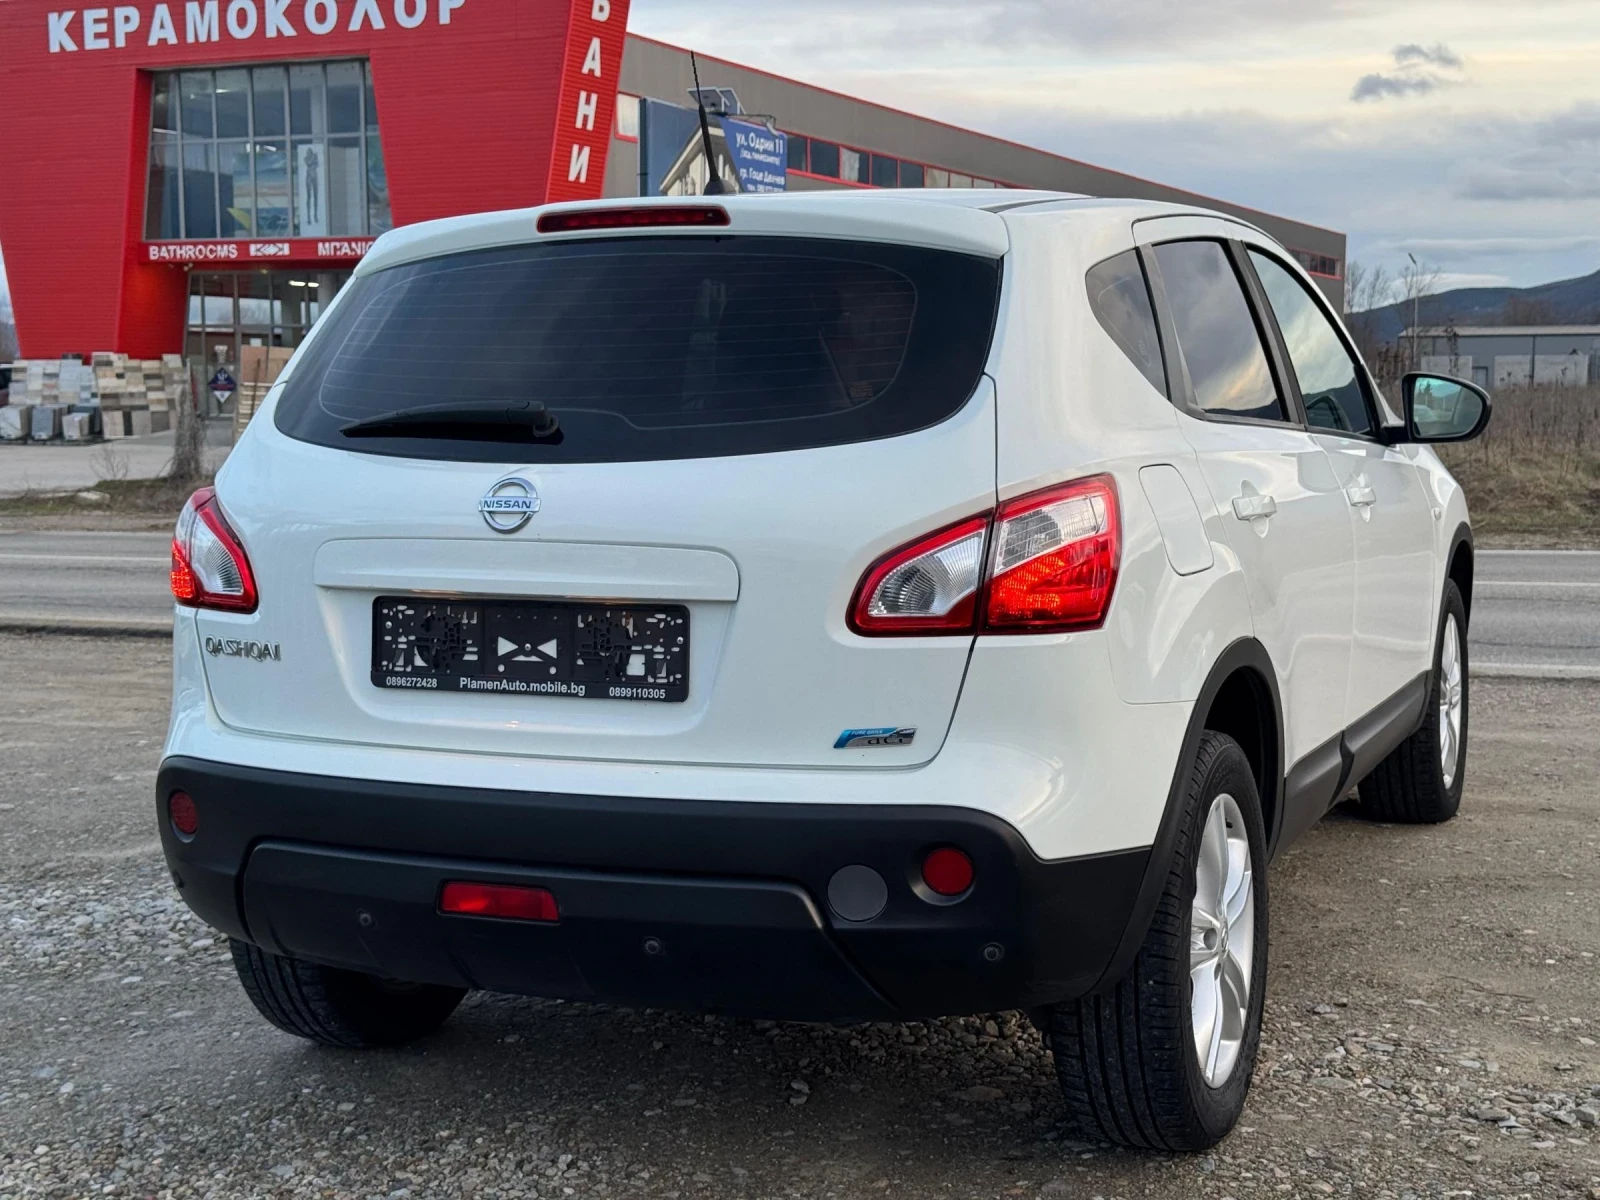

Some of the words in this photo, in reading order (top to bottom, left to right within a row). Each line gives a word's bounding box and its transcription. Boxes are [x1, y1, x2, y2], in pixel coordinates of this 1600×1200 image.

[48, 0, 466, 53] КЕРАМОКОЛОР
[736, 132, 747, 147] ул.
[749, 132, 774, 152] Одрин
[775, 139, 783, 154] 11
[483, 499, 532, 509] NISSAN
[205, 635, 281, 662] QASHQAI
[386, 676, 438, 688] 0896272428
[459, 676, 586, 697] PlamenAuto.mobile.bg
[608, 686, 666, 699] 0899110305
